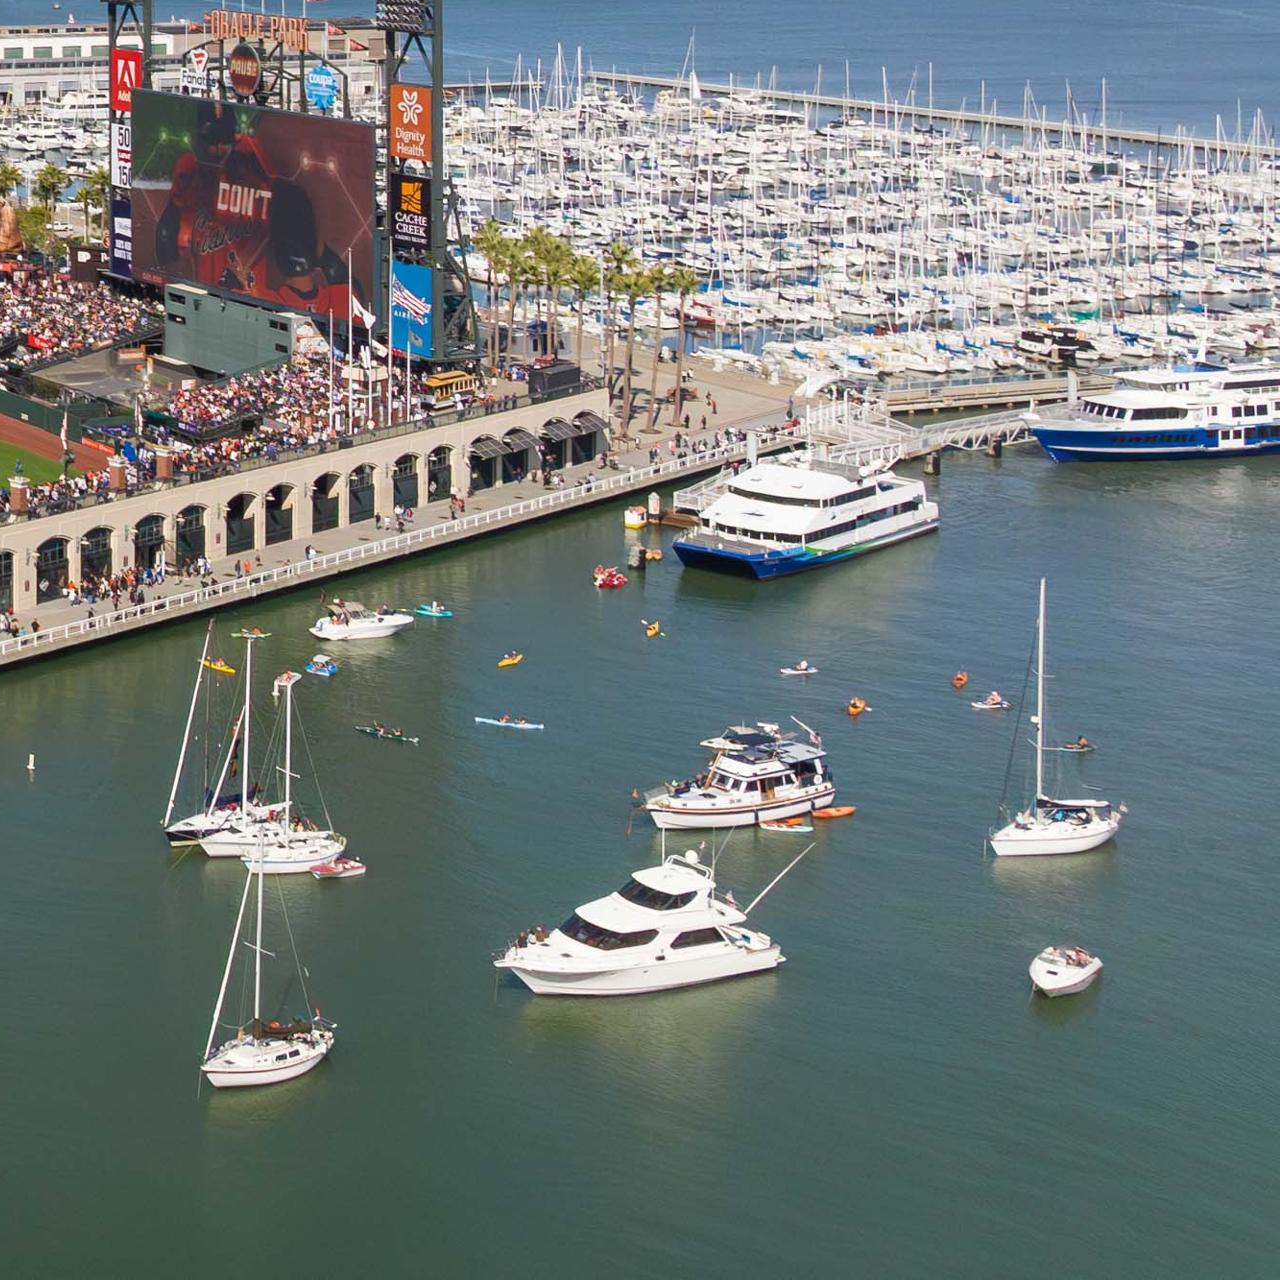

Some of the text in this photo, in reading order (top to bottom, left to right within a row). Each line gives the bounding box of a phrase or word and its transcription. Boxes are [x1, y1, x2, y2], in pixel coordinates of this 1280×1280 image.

[210, 10, 309, 53] ORACLE PARK
[395, 127, 425, 146] Dignity
[397, 142, 425, 157] Health
[216, 181, 272, 220] DON'T
[395, 211, 428, 227] CACHE
[396, 223, 427, 237] CREEK
